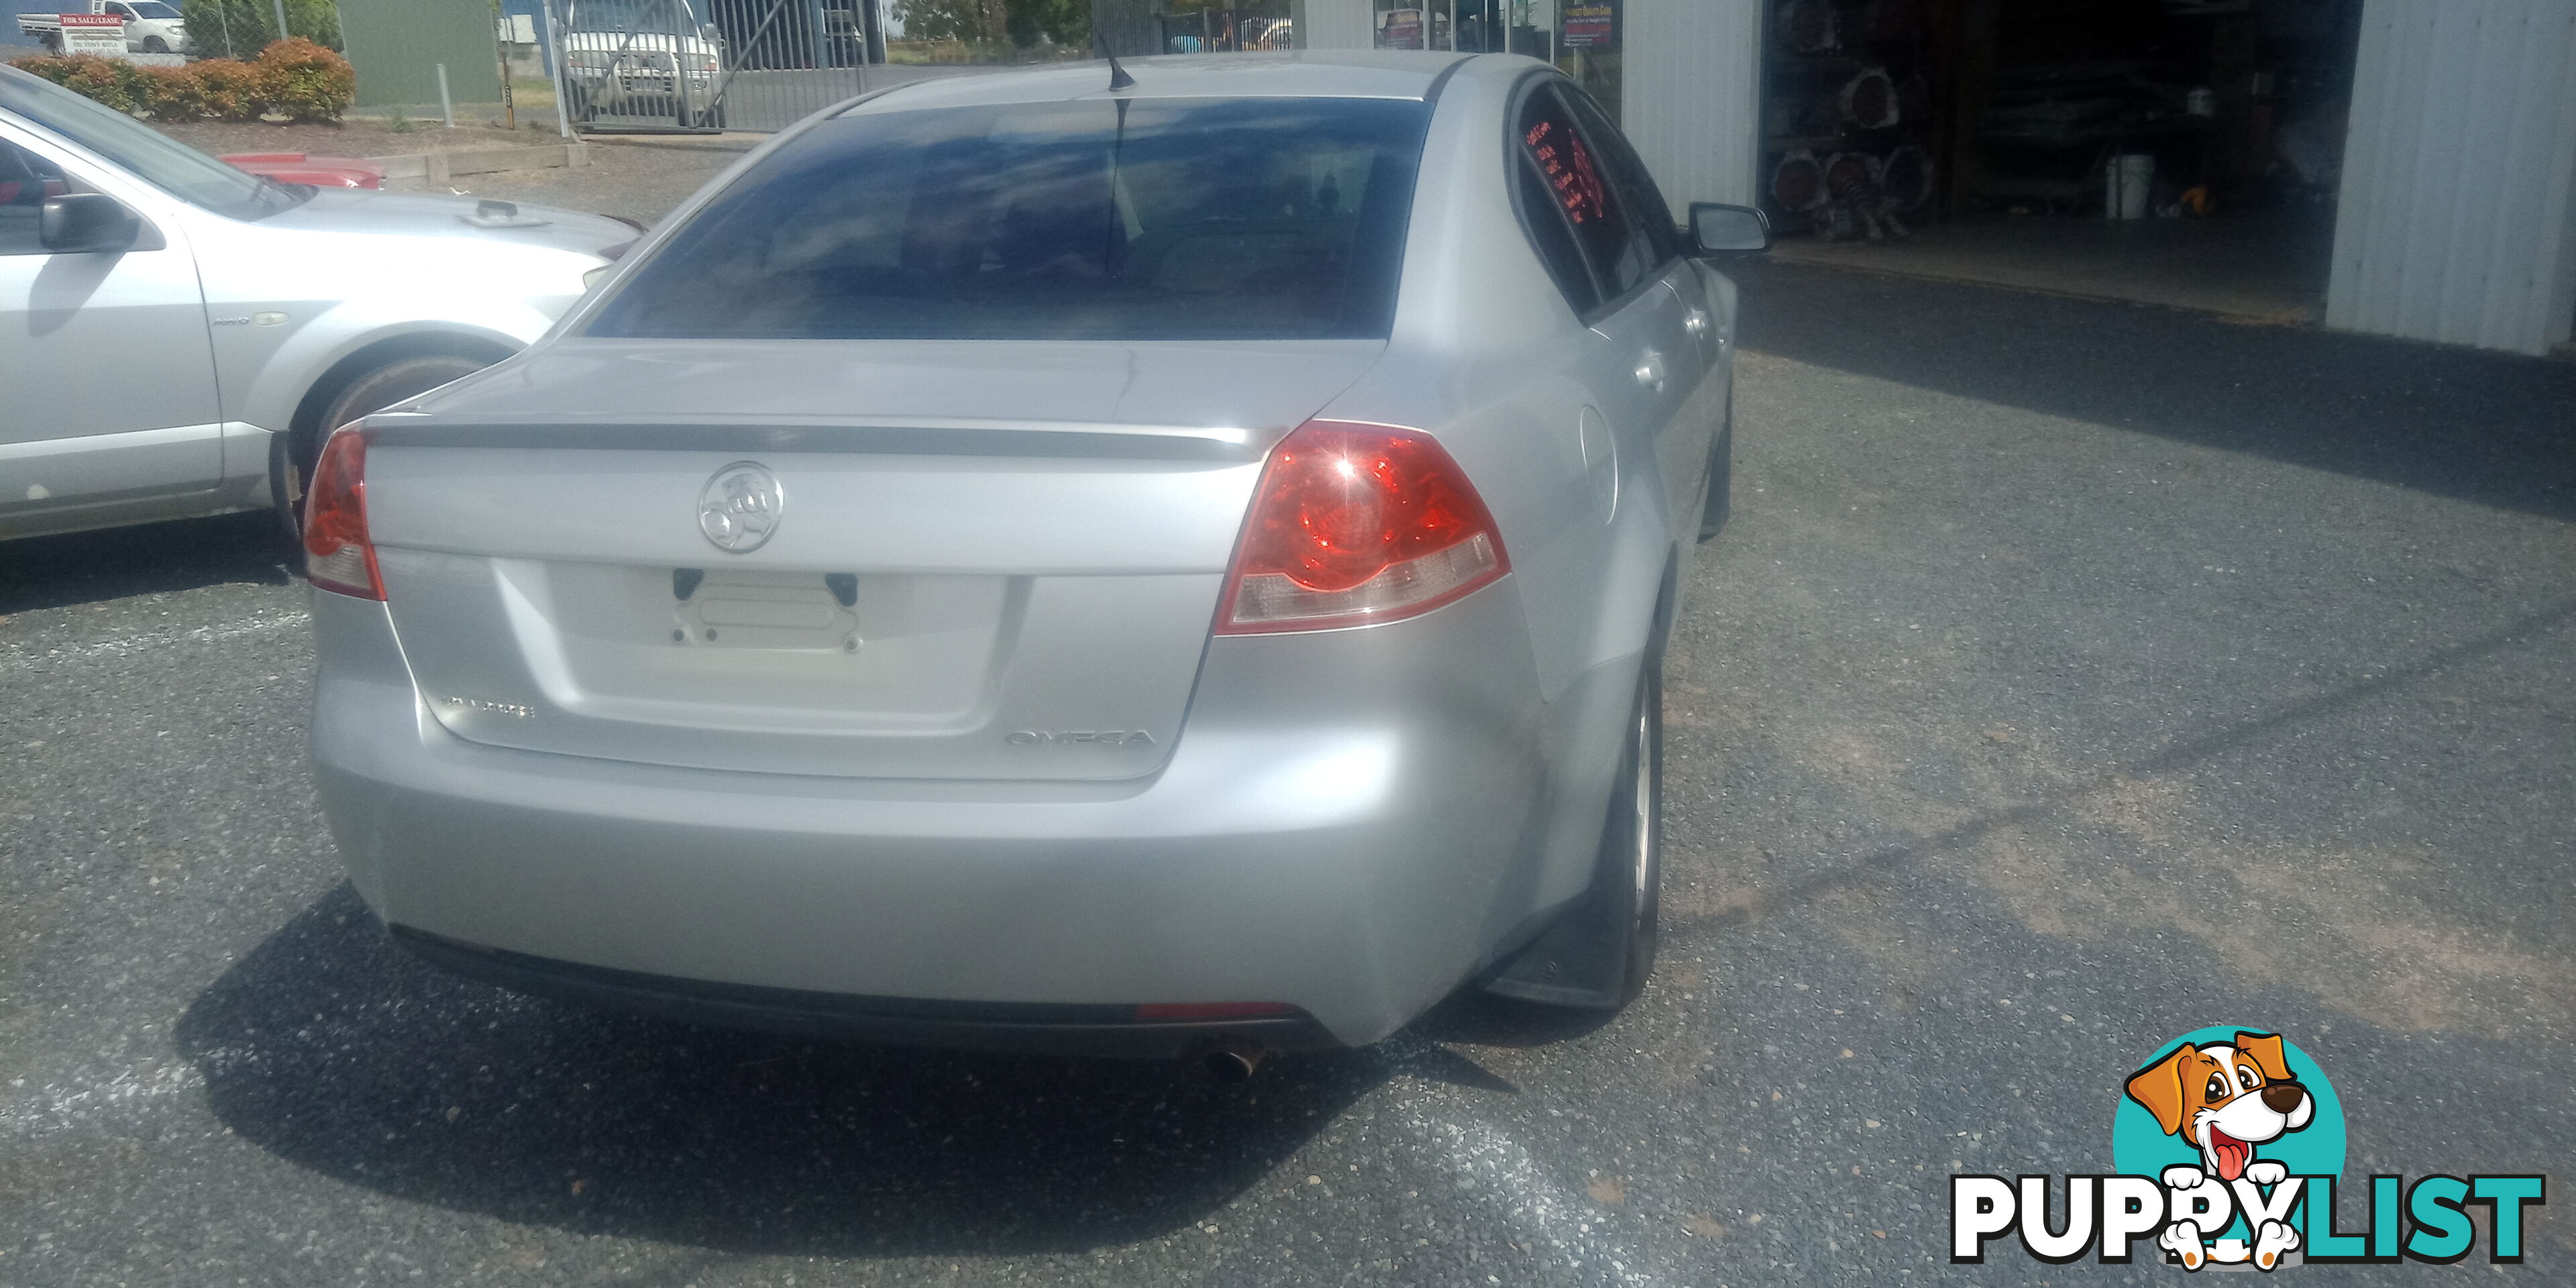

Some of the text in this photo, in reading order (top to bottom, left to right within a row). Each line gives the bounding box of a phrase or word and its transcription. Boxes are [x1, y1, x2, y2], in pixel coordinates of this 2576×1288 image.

[78, 16, 119, 24] SALE/LEASE
[213, 317, 250, 326] AWD
[1008, 729, 1157, 746] OMEGA
